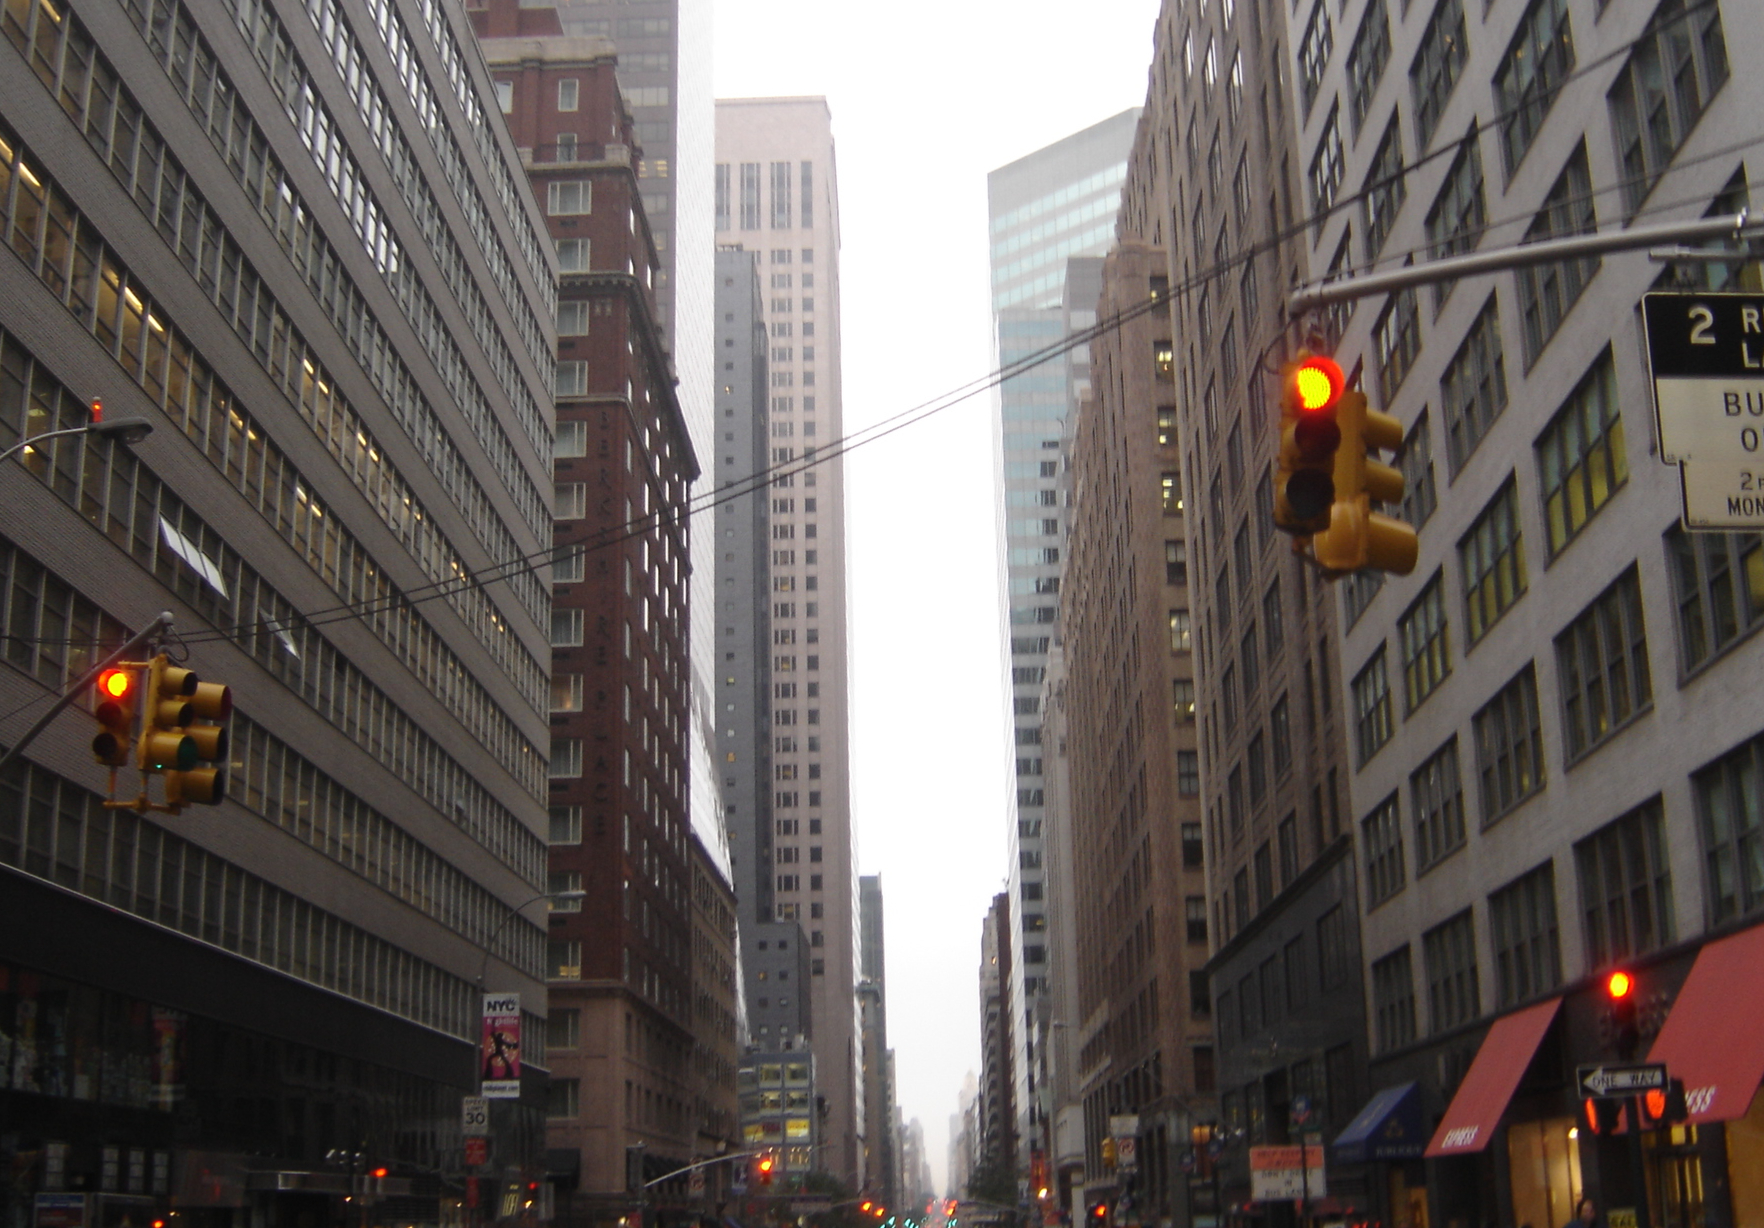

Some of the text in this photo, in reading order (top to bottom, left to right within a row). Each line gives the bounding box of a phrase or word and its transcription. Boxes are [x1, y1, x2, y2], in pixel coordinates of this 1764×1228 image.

[1688, 307, 1764, 345] 2 R
[1742, 341, 1764, 369] L
[1741, 427, 1764, 453] O
[487, 998, 516, 1012] NYC
[1592, 1070, 1658, 1088] ONE WAY
[465, 1112, 486, 1125] 30
[1441, 1124, 1479, 1149] EXPRESS
